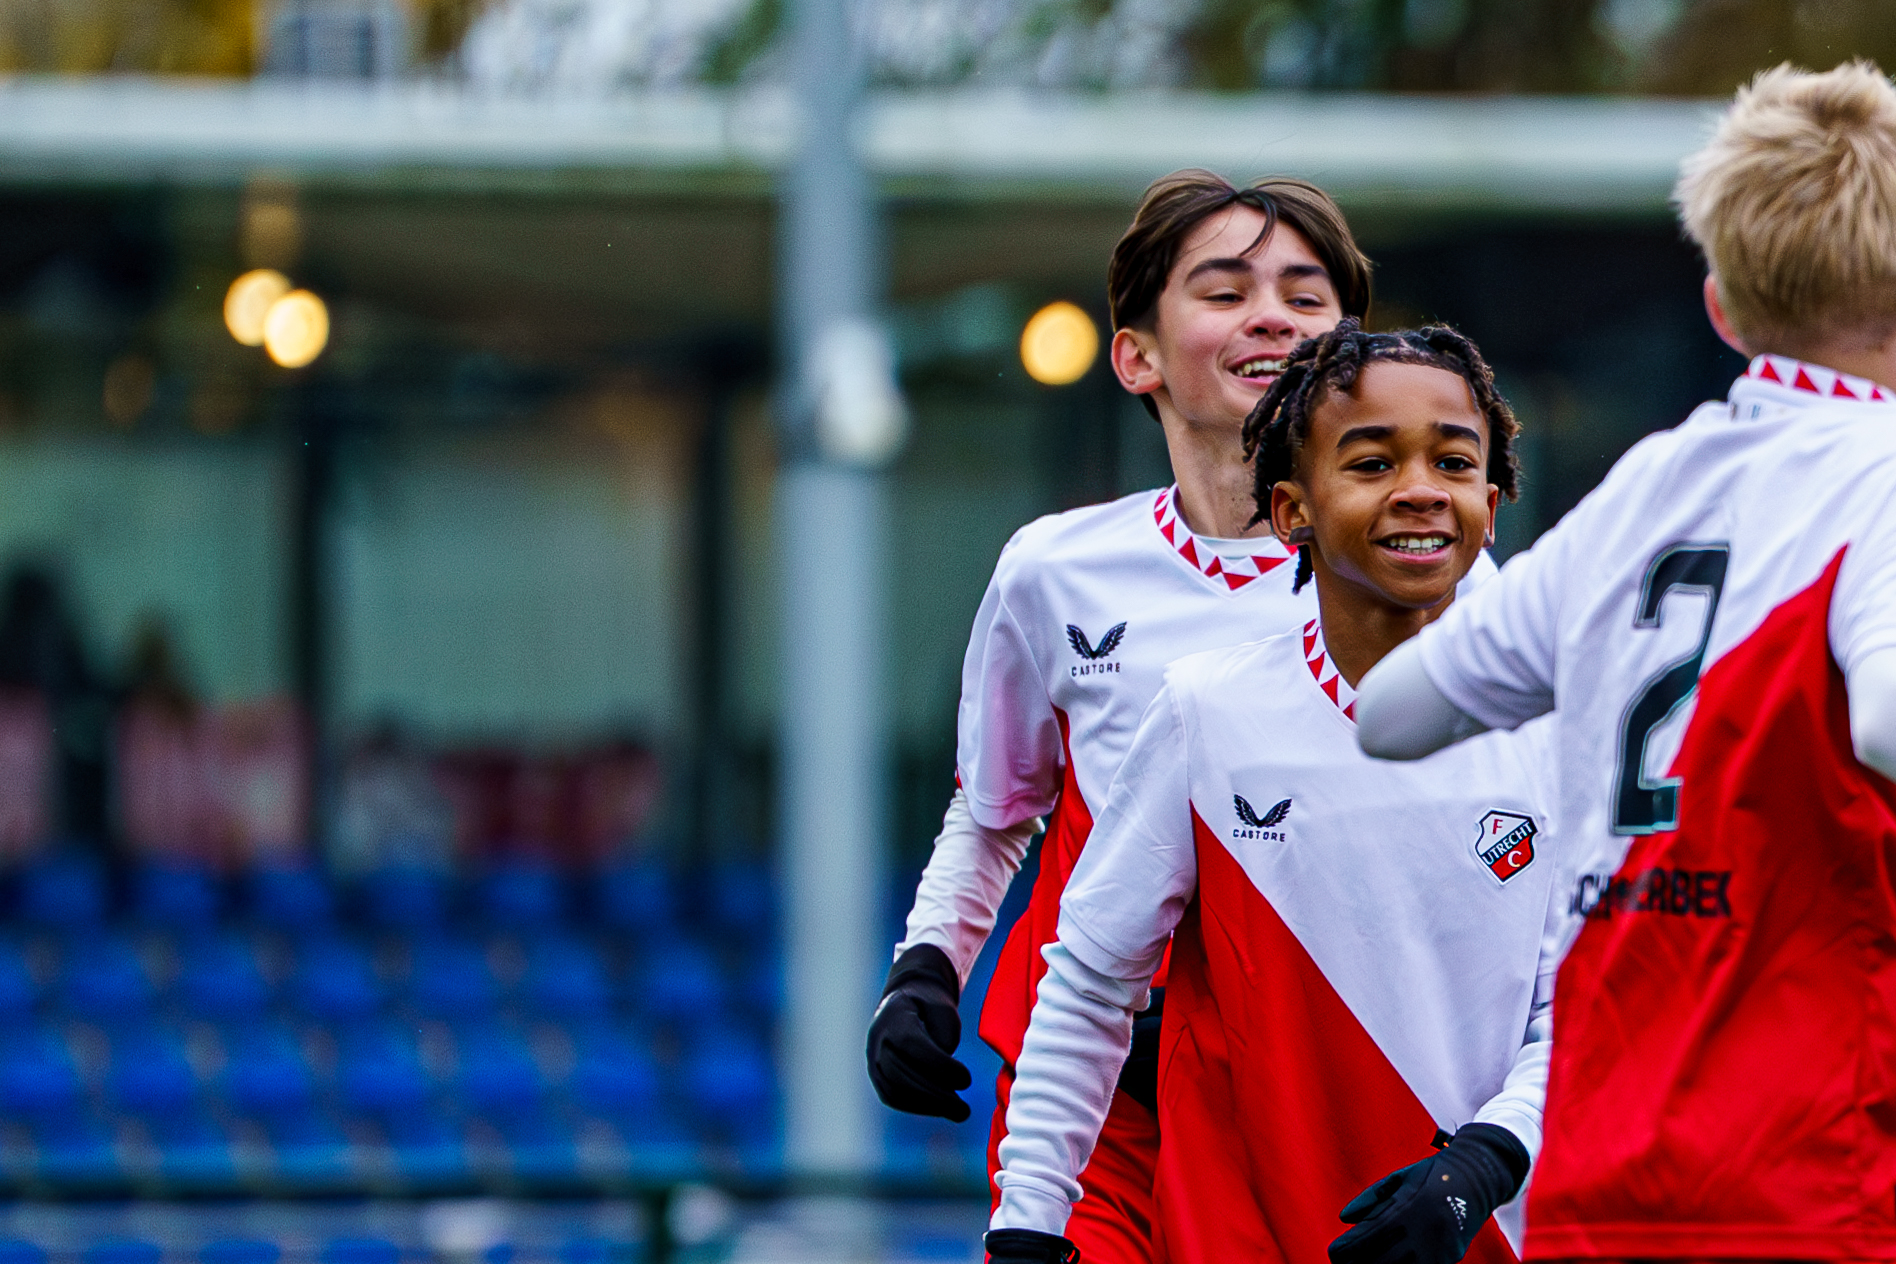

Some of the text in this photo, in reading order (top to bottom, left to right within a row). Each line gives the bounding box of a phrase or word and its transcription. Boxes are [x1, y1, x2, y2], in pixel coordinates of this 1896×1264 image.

[1071, 662, 1120, 677] CASTORE
[1609, 541, 1730, 836] 2
[1232, 828, 1286, 842] CASTORE
[1492, 818, 1503, 835] F
[1481, 821, 1533, 866] UTRECHT
[1507, 850, 1522, 868] C
